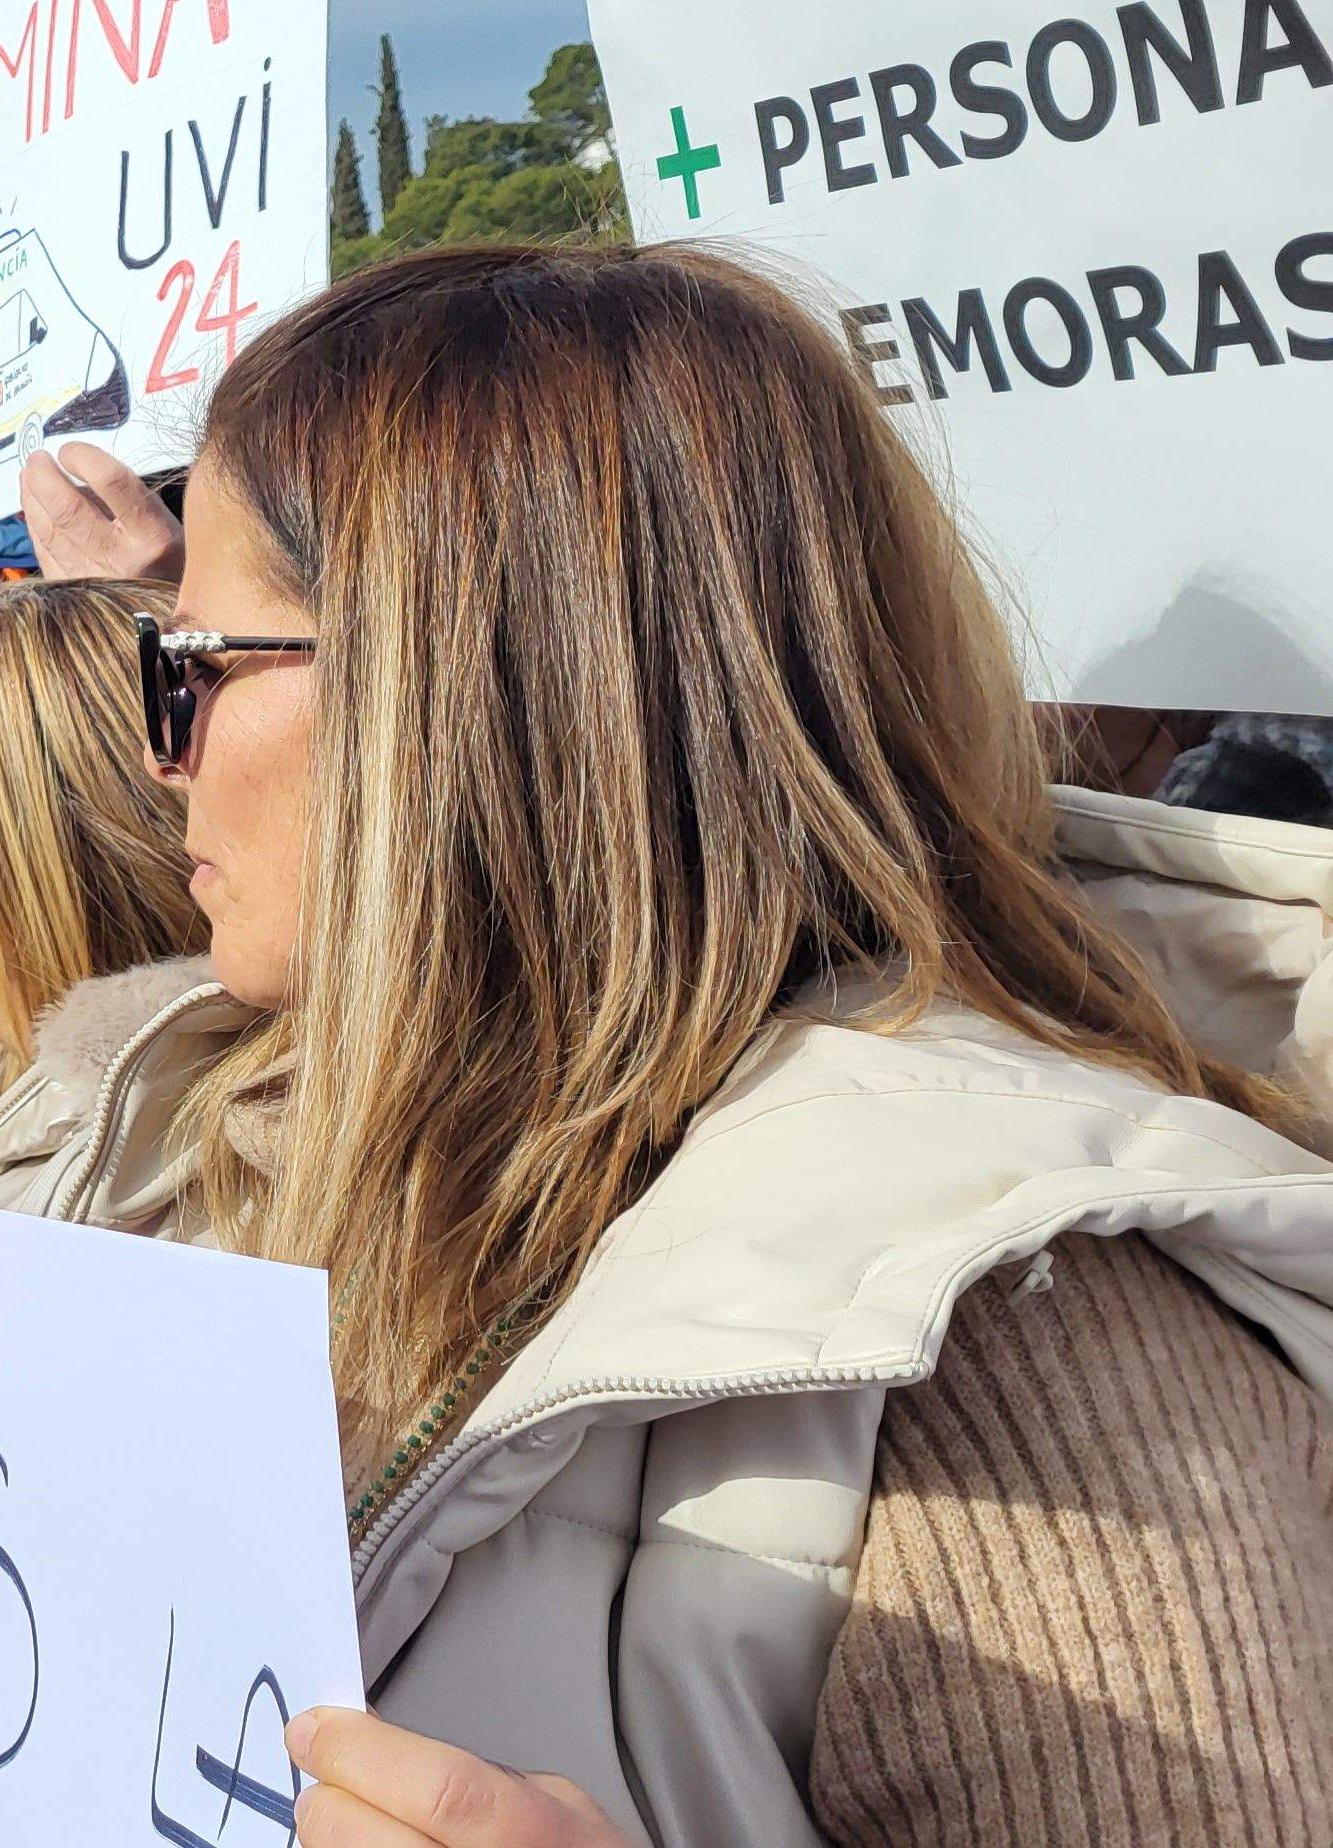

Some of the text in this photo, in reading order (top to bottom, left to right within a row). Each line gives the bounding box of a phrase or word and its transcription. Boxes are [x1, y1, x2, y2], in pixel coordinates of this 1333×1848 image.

[754, 0, 1333, 205] PERSONA
[145, 240, 258, 394] 24
[151, 1600, 302, 1848] LA
